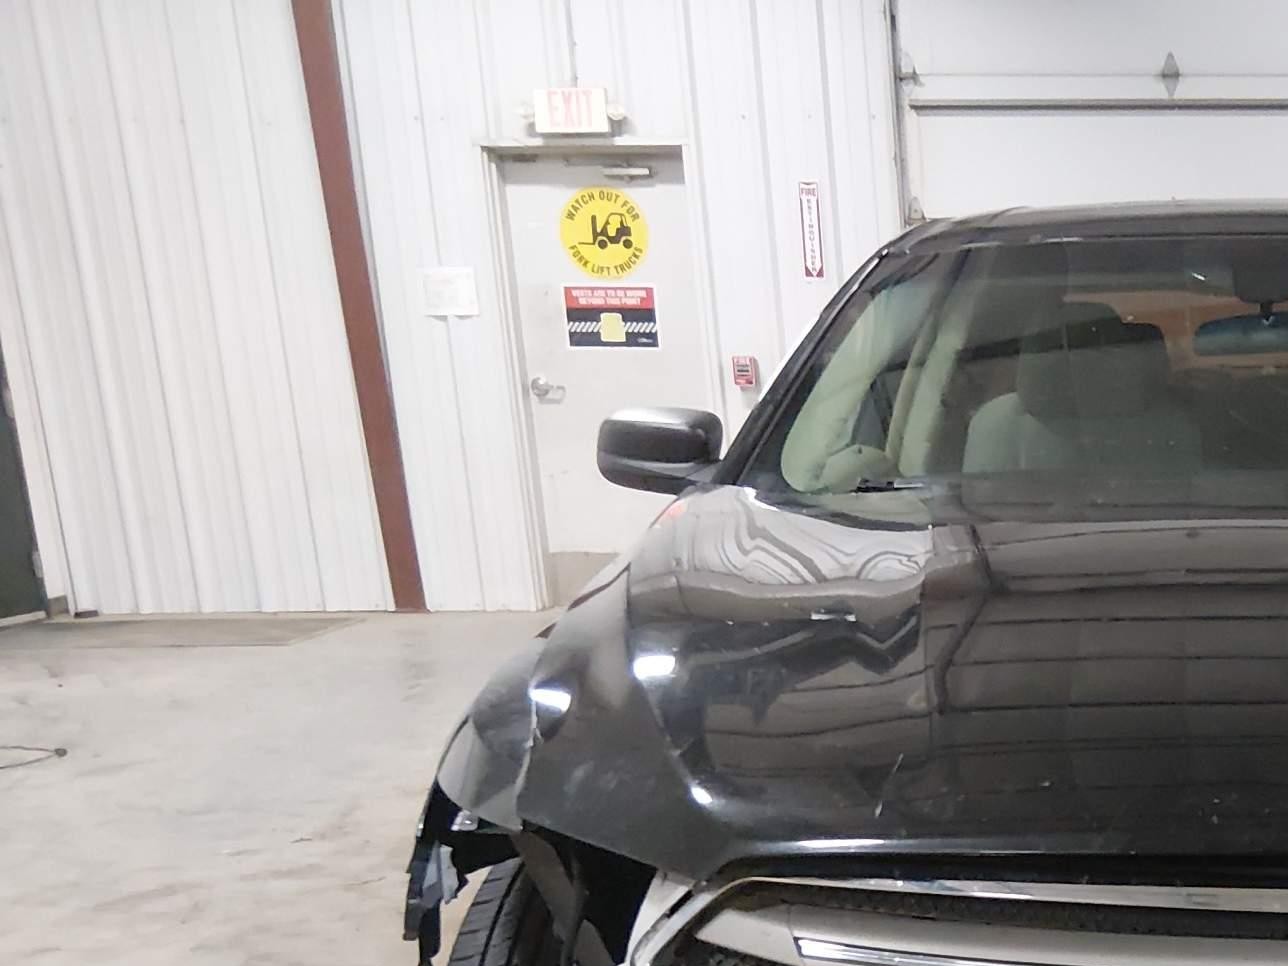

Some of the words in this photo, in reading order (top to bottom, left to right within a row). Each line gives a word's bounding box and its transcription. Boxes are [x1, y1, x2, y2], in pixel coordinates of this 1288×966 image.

[547, 89, 593, 129] EXIT
[565, 191, 596, 221] WATCH
[599, 190, 620, 204] OUT
[620, 200, 640, 222] FOR
[800, 187, 817, 197] FIRE
[568, 245, 591, 269] FORK
[591, 263, 611, 276] LIFT
[613, 246, 644, 275] TRUCKS
